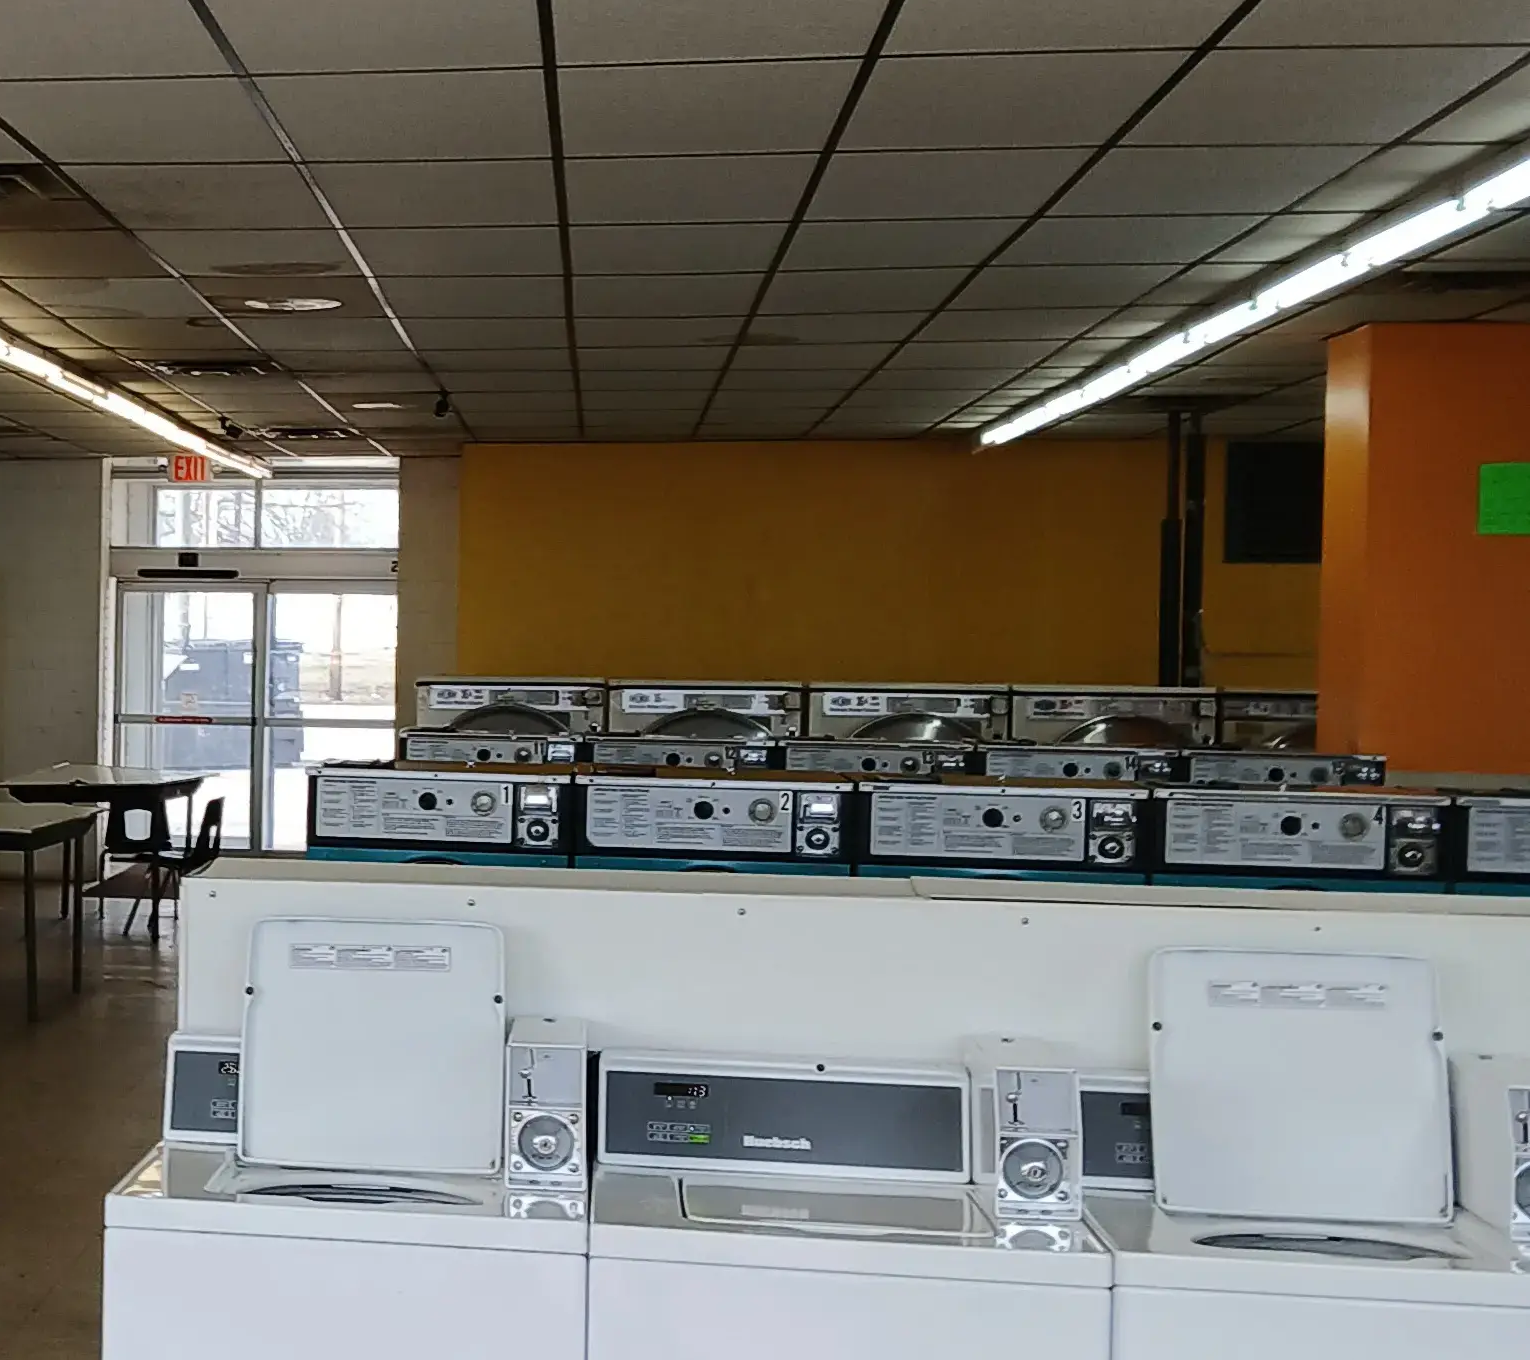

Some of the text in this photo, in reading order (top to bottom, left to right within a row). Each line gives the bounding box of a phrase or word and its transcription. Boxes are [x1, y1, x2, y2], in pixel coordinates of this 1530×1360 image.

[174, 455, 206, 481] EXIT
[503, 785, 509, 804] 1
[781, 792, 790, 811] 2
[1072, 800, 1083, 820] 3
[1373, 806, 1384, 825] 4
